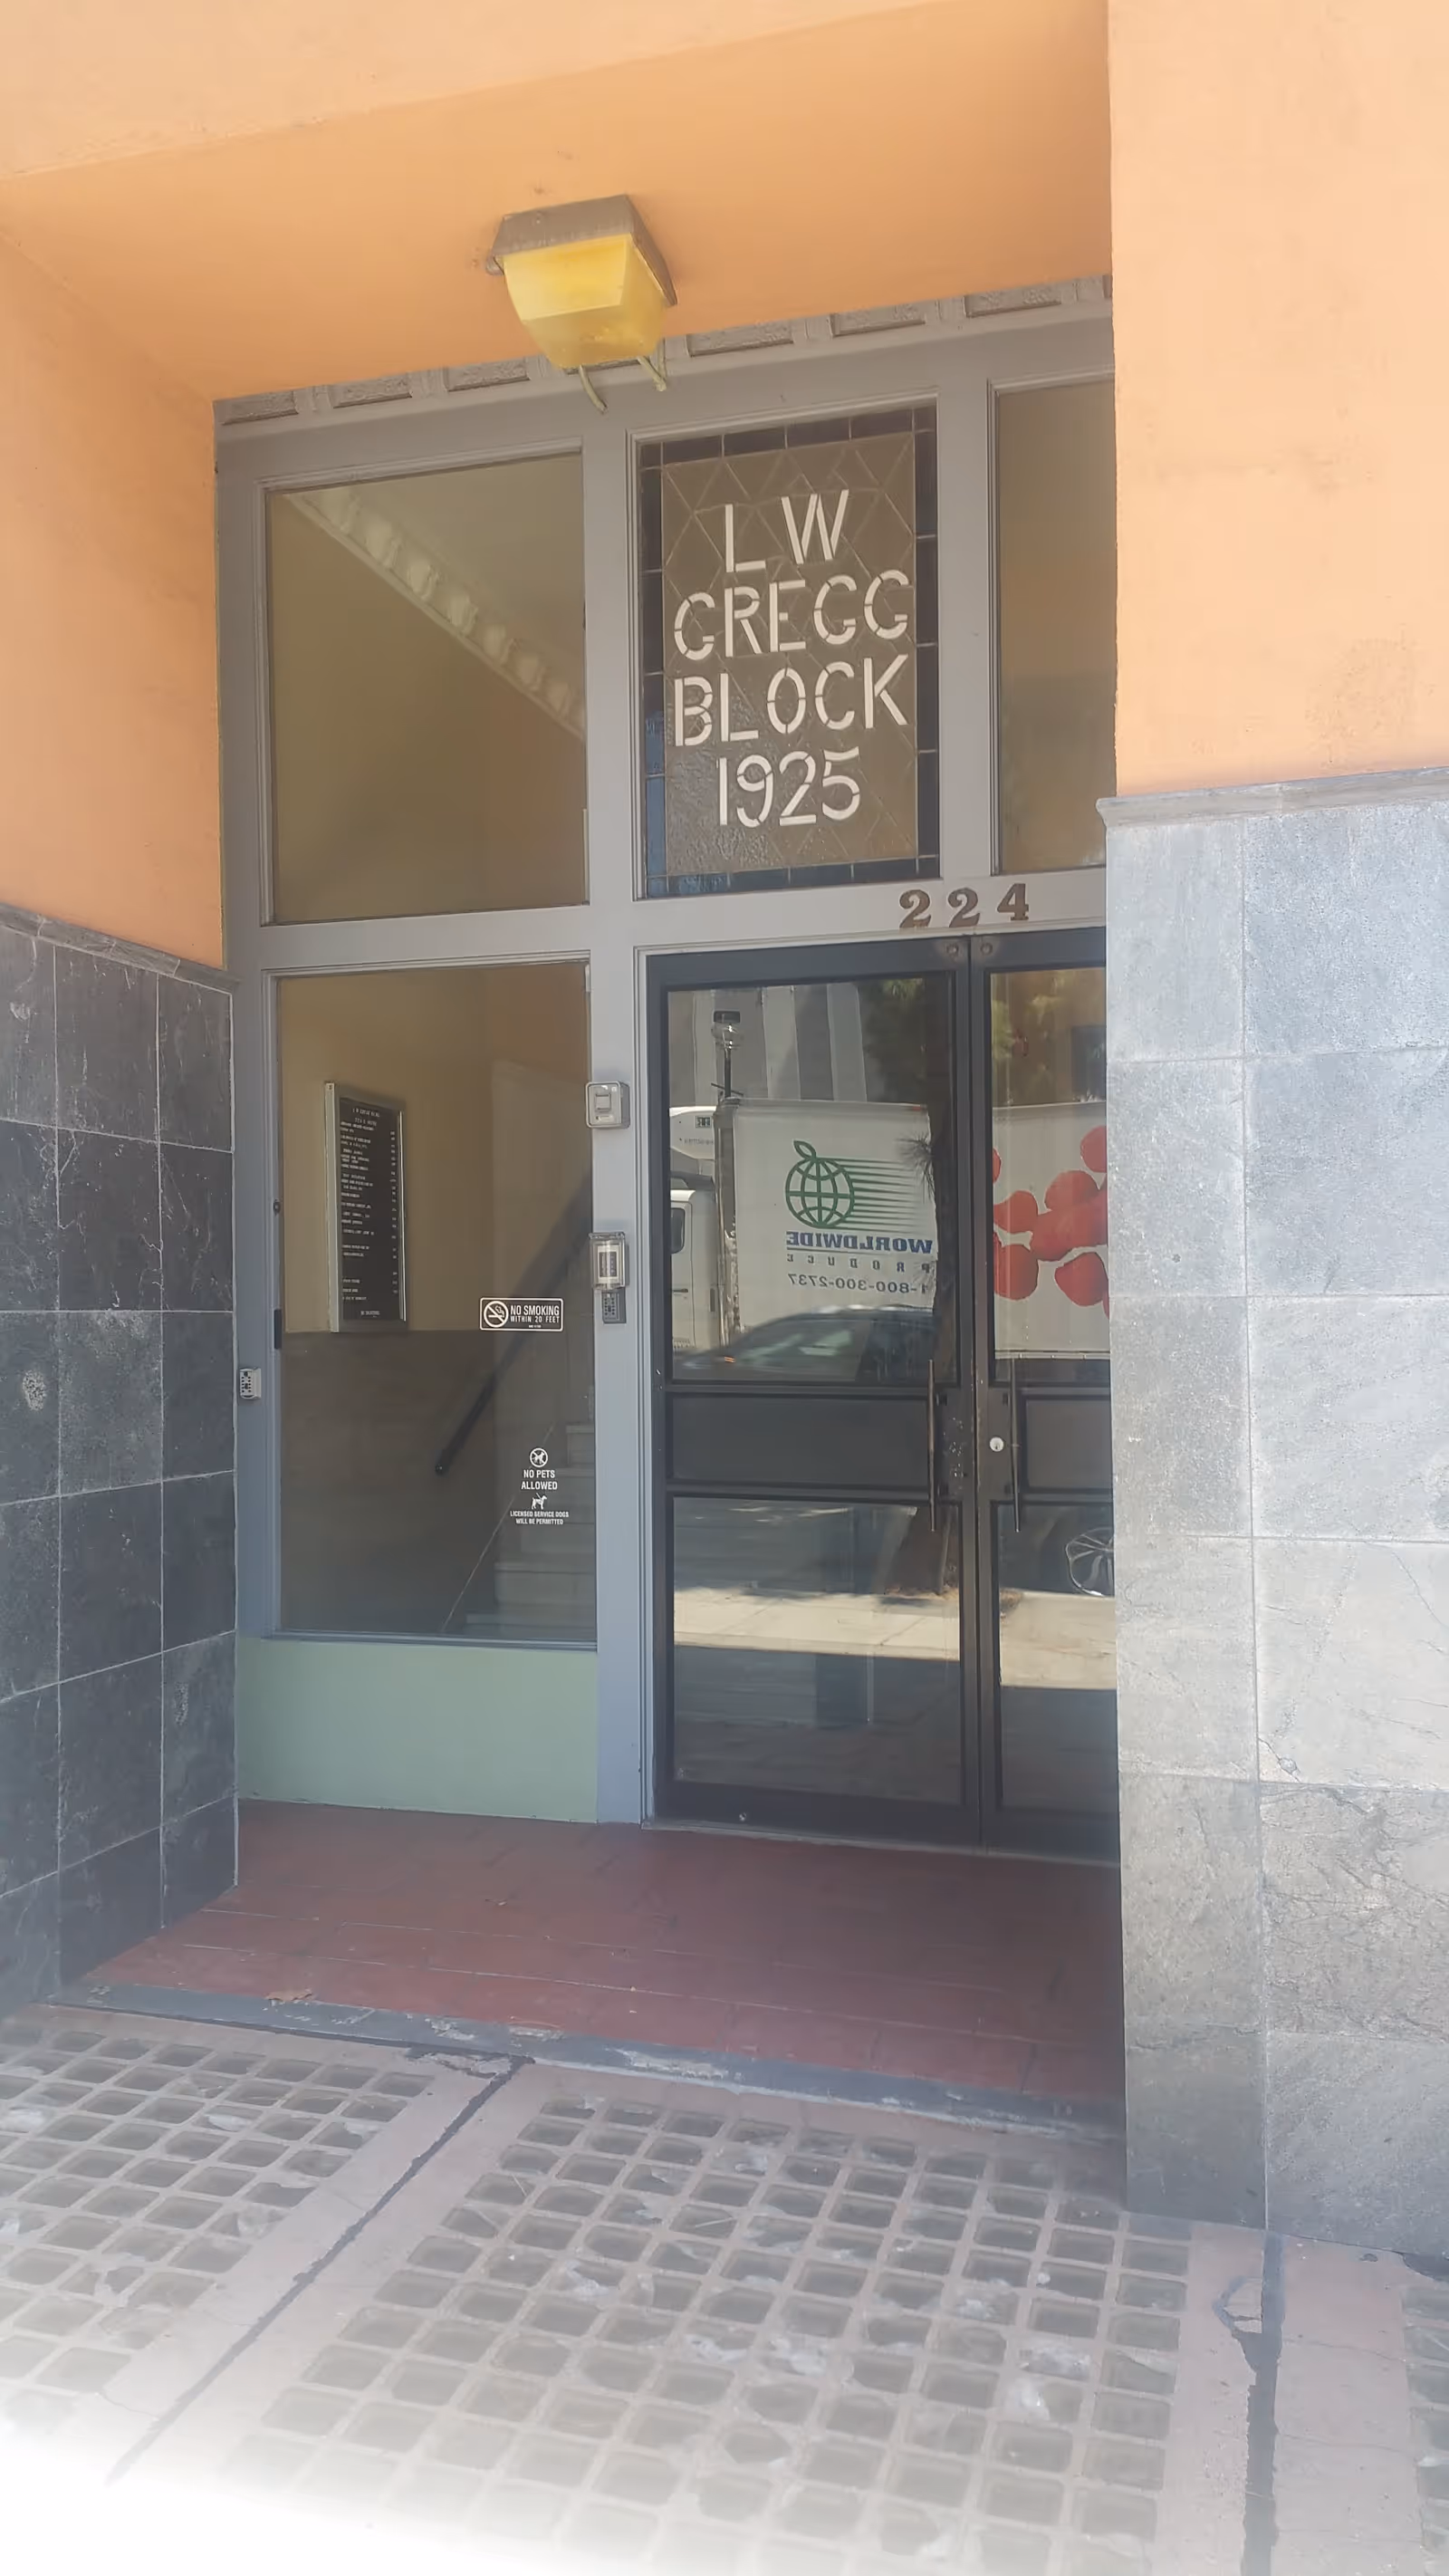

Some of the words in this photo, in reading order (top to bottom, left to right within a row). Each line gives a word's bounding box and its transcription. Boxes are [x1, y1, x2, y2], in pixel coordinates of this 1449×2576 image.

[724, 504, 766, 573] L
[781, 489, 849, 564] W
[674, 654, 909, 747] BLOCK
[716, 745, 860, 828] 1925
[899, 883, 1029, 928] 224
[511, 1305, 522, 1315] NO
[523, 1305, 560, 1315] SMOKING
[521, 1481, 558, 1490] ALLOWED
[523, 1469, 534, 1478] NO
[536, 1469, 555, 1478] PETS
